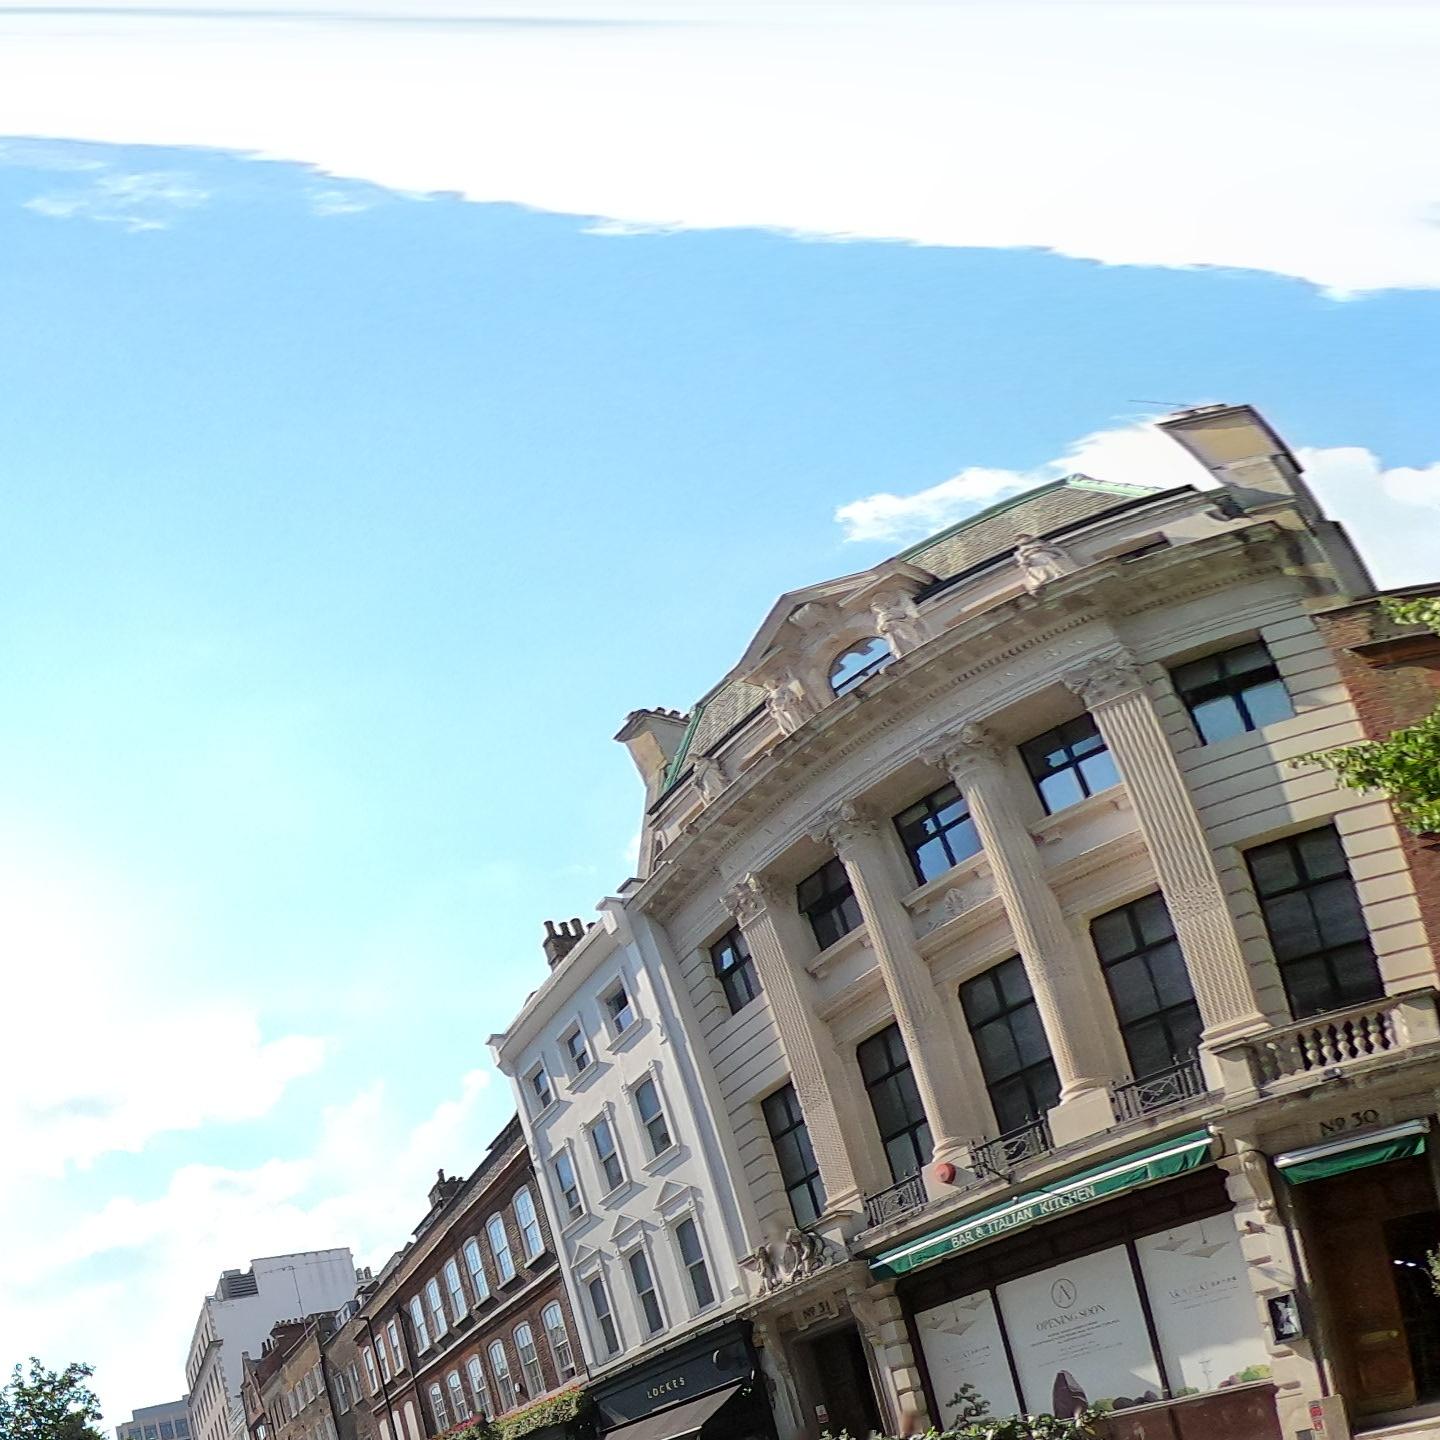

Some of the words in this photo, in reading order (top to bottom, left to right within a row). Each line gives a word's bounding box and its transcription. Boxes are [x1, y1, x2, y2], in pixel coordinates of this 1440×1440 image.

[1350, 1109, 1380, 1128] 30
[950, 1230, 975, 1249] BAR
[975, 1226, 985, 1238] &
[988, 1207, 1034, 1234] ITALIAN
[1039, 1185, 1096, 1214] KITCHEN
[1035, 1311, 1078, 1332] OPENING
[1078, 1303, 1109, 1320] SOON
[646, 1376, 686, 1400] LOCKES
